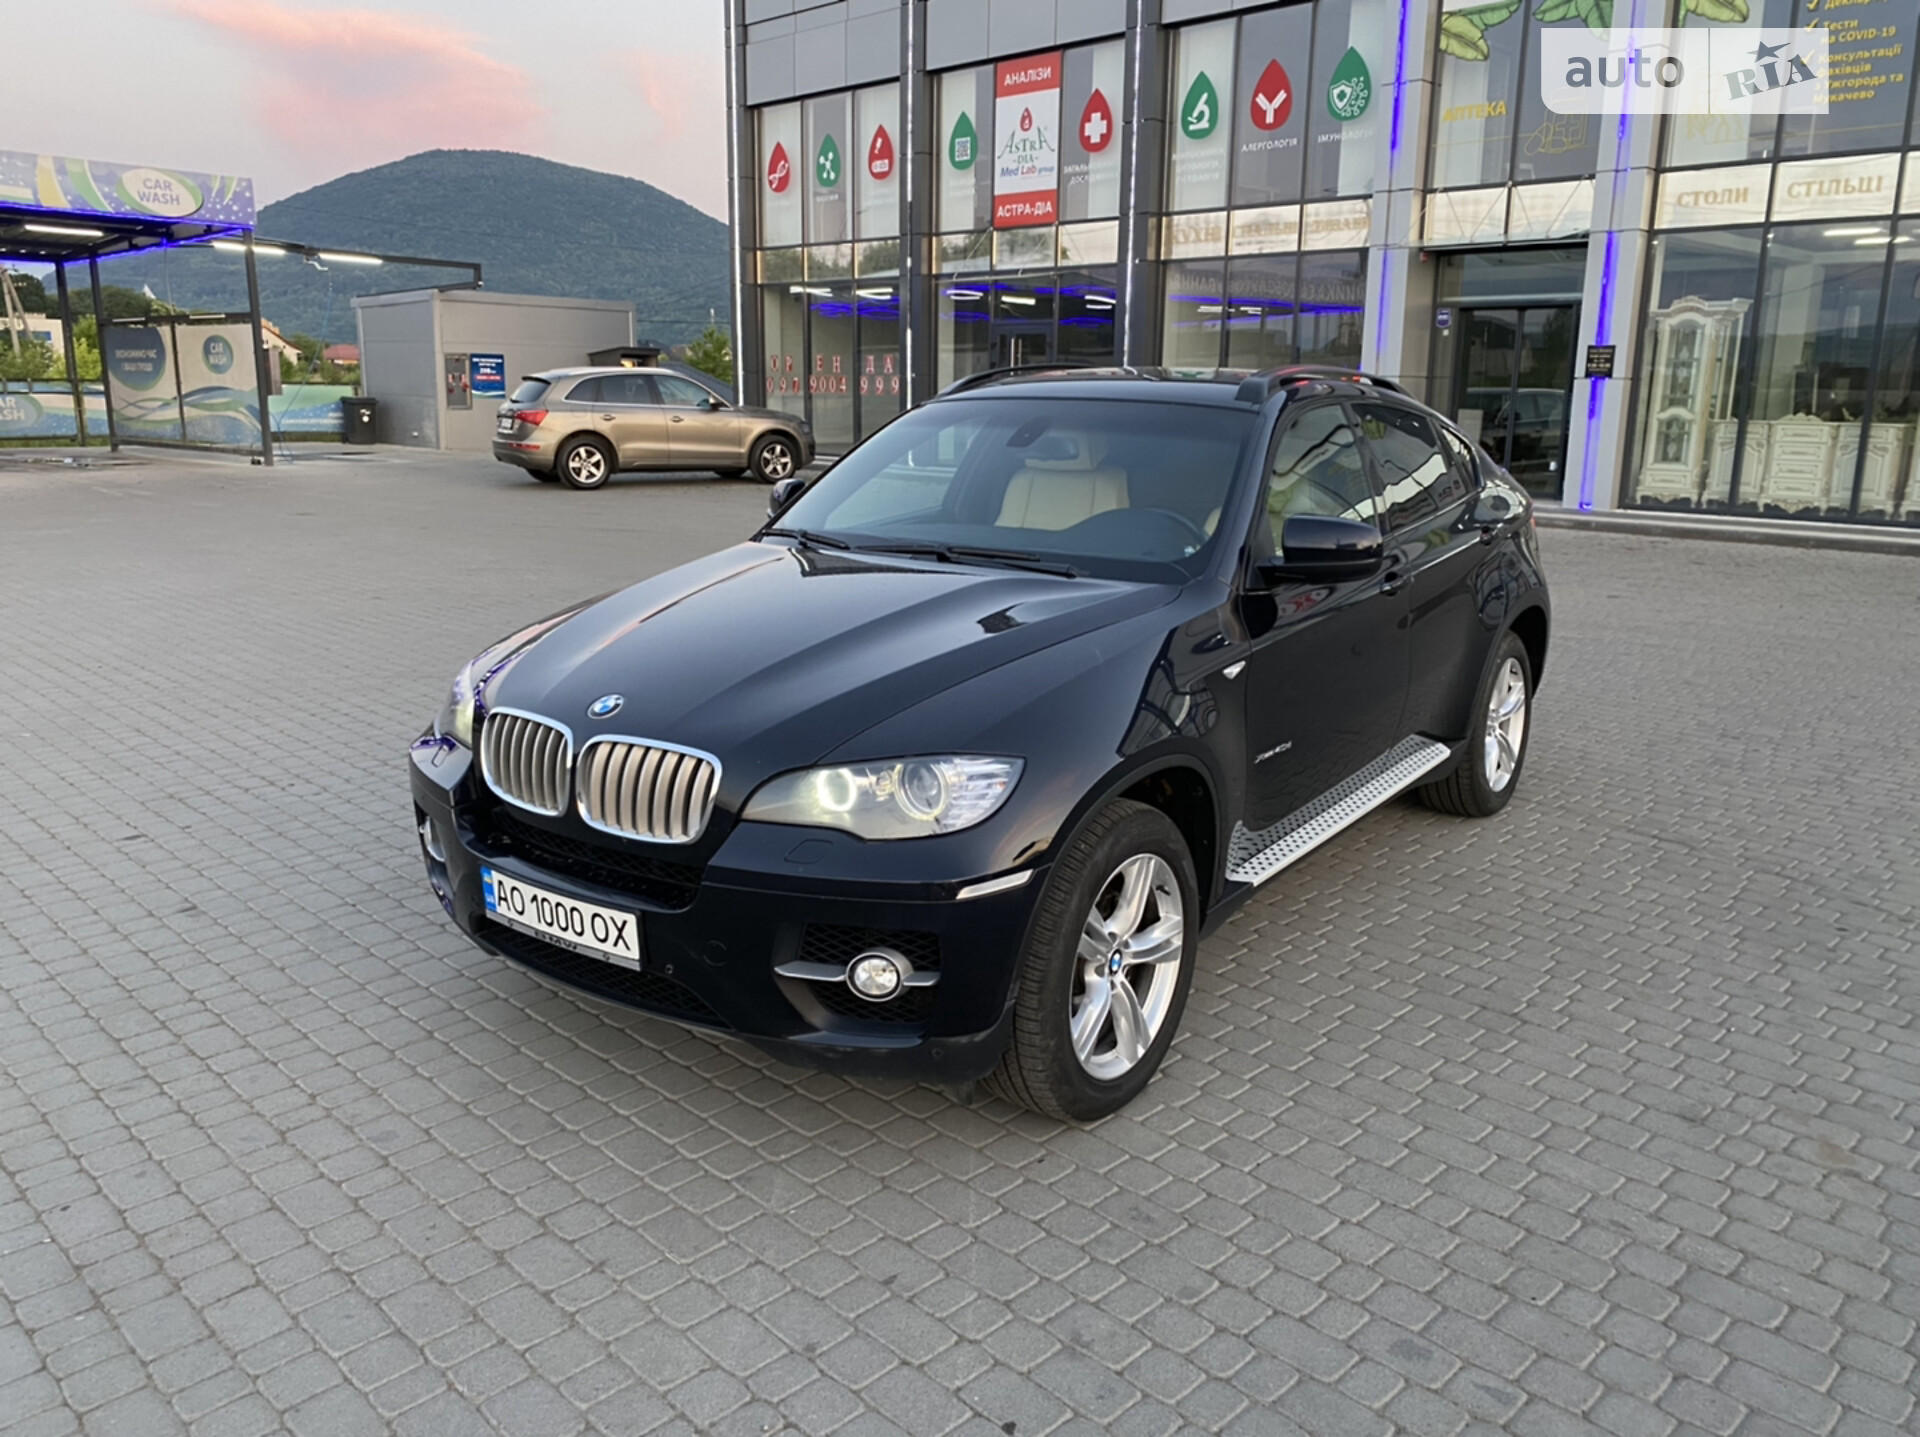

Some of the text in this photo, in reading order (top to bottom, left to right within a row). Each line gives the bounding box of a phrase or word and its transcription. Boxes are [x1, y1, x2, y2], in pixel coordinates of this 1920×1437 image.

[1823, 19, 1858, 31] Тести
[1839, 26, 1896, 42] COVID-19
[1004, 66, 1052, 87] АНАЛІЗИ
[1442, 100, 1507, 123] АПТЕКА
[1241, 137, 1299, 152] АЛЕРГОЛОГІЯ
[1001, 166, 1019, 177] Med
[1021, 165, 1037, 176] Lab
[143, 178, 173, 192] CAR
[137, 190, 180, 206] WASH
[1677, 187, 1749, 207] СТОЛИ
[997, 201, 1053, 218] АСТРА-ДІА
[210, 342, 223, 353] CAR
[497, 879, 525, 916] AO
[530, 894, 585, 937] 1000
[591, 912, 631, 952] OX
